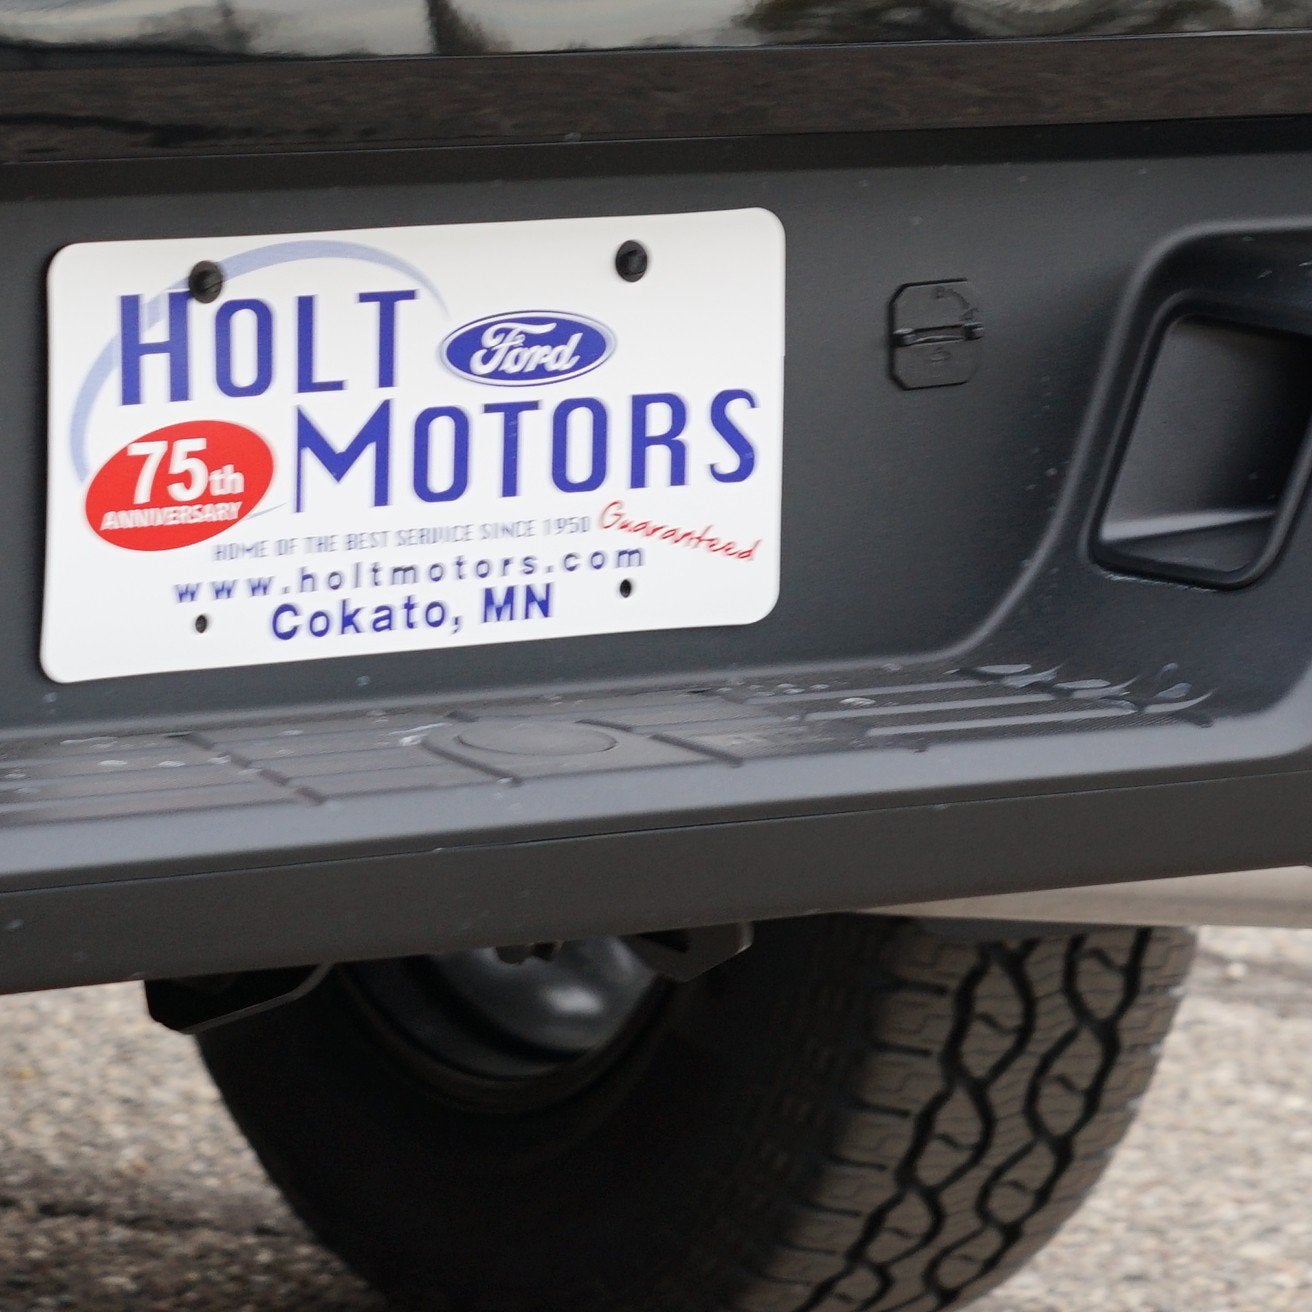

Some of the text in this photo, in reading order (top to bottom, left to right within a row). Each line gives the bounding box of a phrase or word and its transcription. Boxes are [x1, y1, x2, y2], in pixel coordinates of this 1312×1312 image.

[119, 288, 418, 407] HOLT
[469, 322, 584, 376] Ford
[126, 437, 246, 505] 75th
[293, 387, 758, 515] MOTORS
[99, 501, 243, 531] ANNIVERSARY
[213, 514, 591, 562] HOME OF THE BEST SERVICE SINCE 1950
[599, 499, 763, 561] Guaranteed
[172, 546, 646, 604] www.holtmotors.com
[269, 582, 554, 642] Cokato, MN
